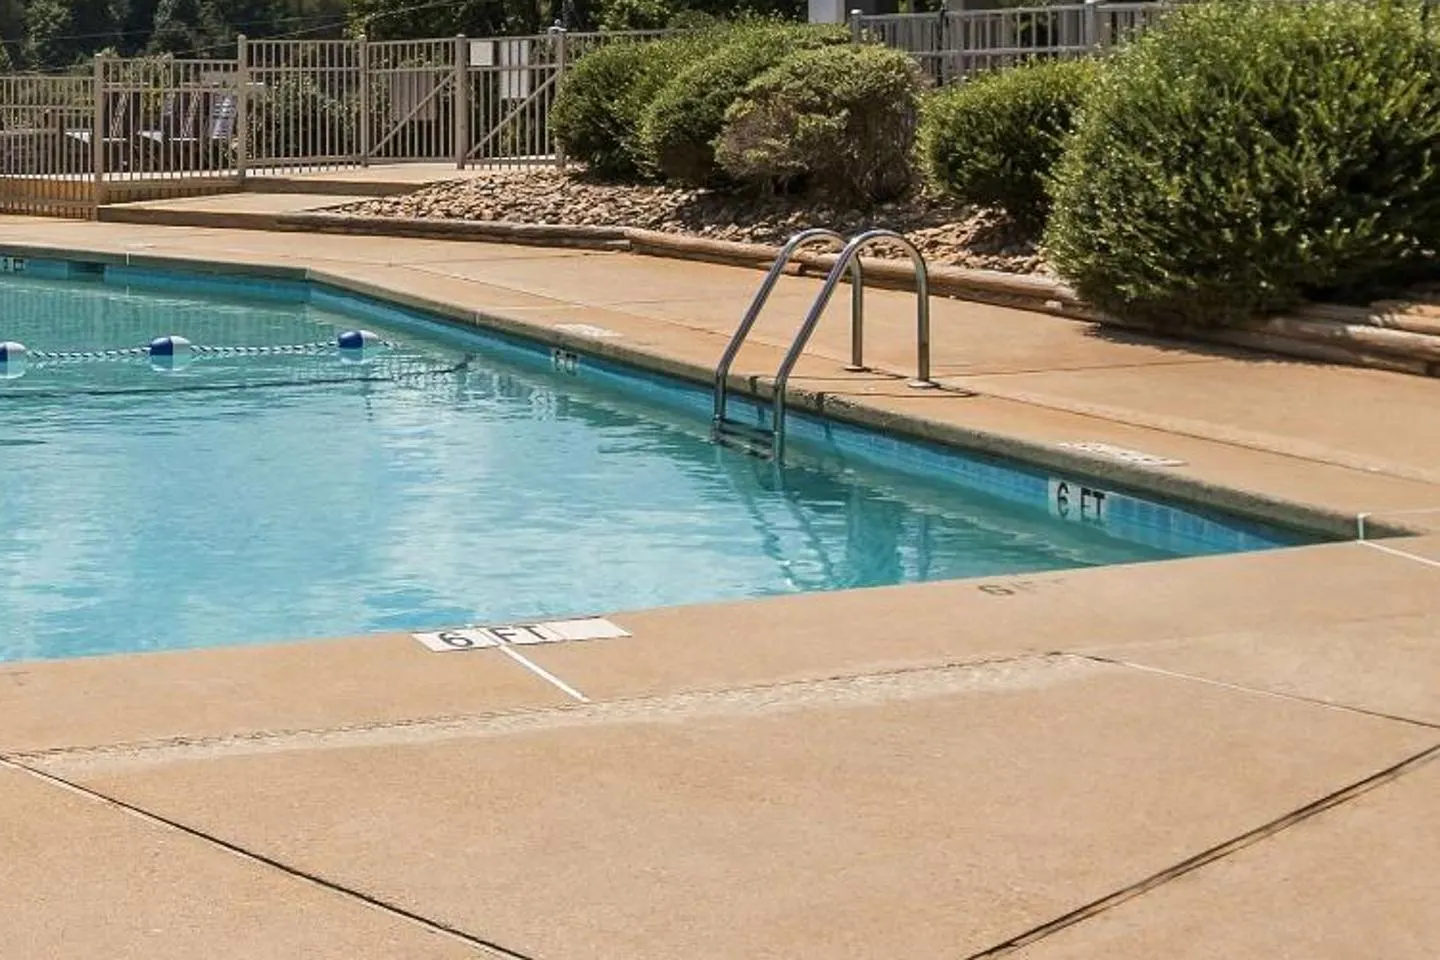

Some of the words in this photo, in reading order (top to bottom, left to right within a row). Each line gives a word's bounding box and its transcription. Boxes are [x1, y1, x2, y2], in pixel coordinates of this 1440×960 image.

[1080, 486, 1106, 517] FT
[438, 632, 473, 648] 6
[488, 625, 548, 644] FT
